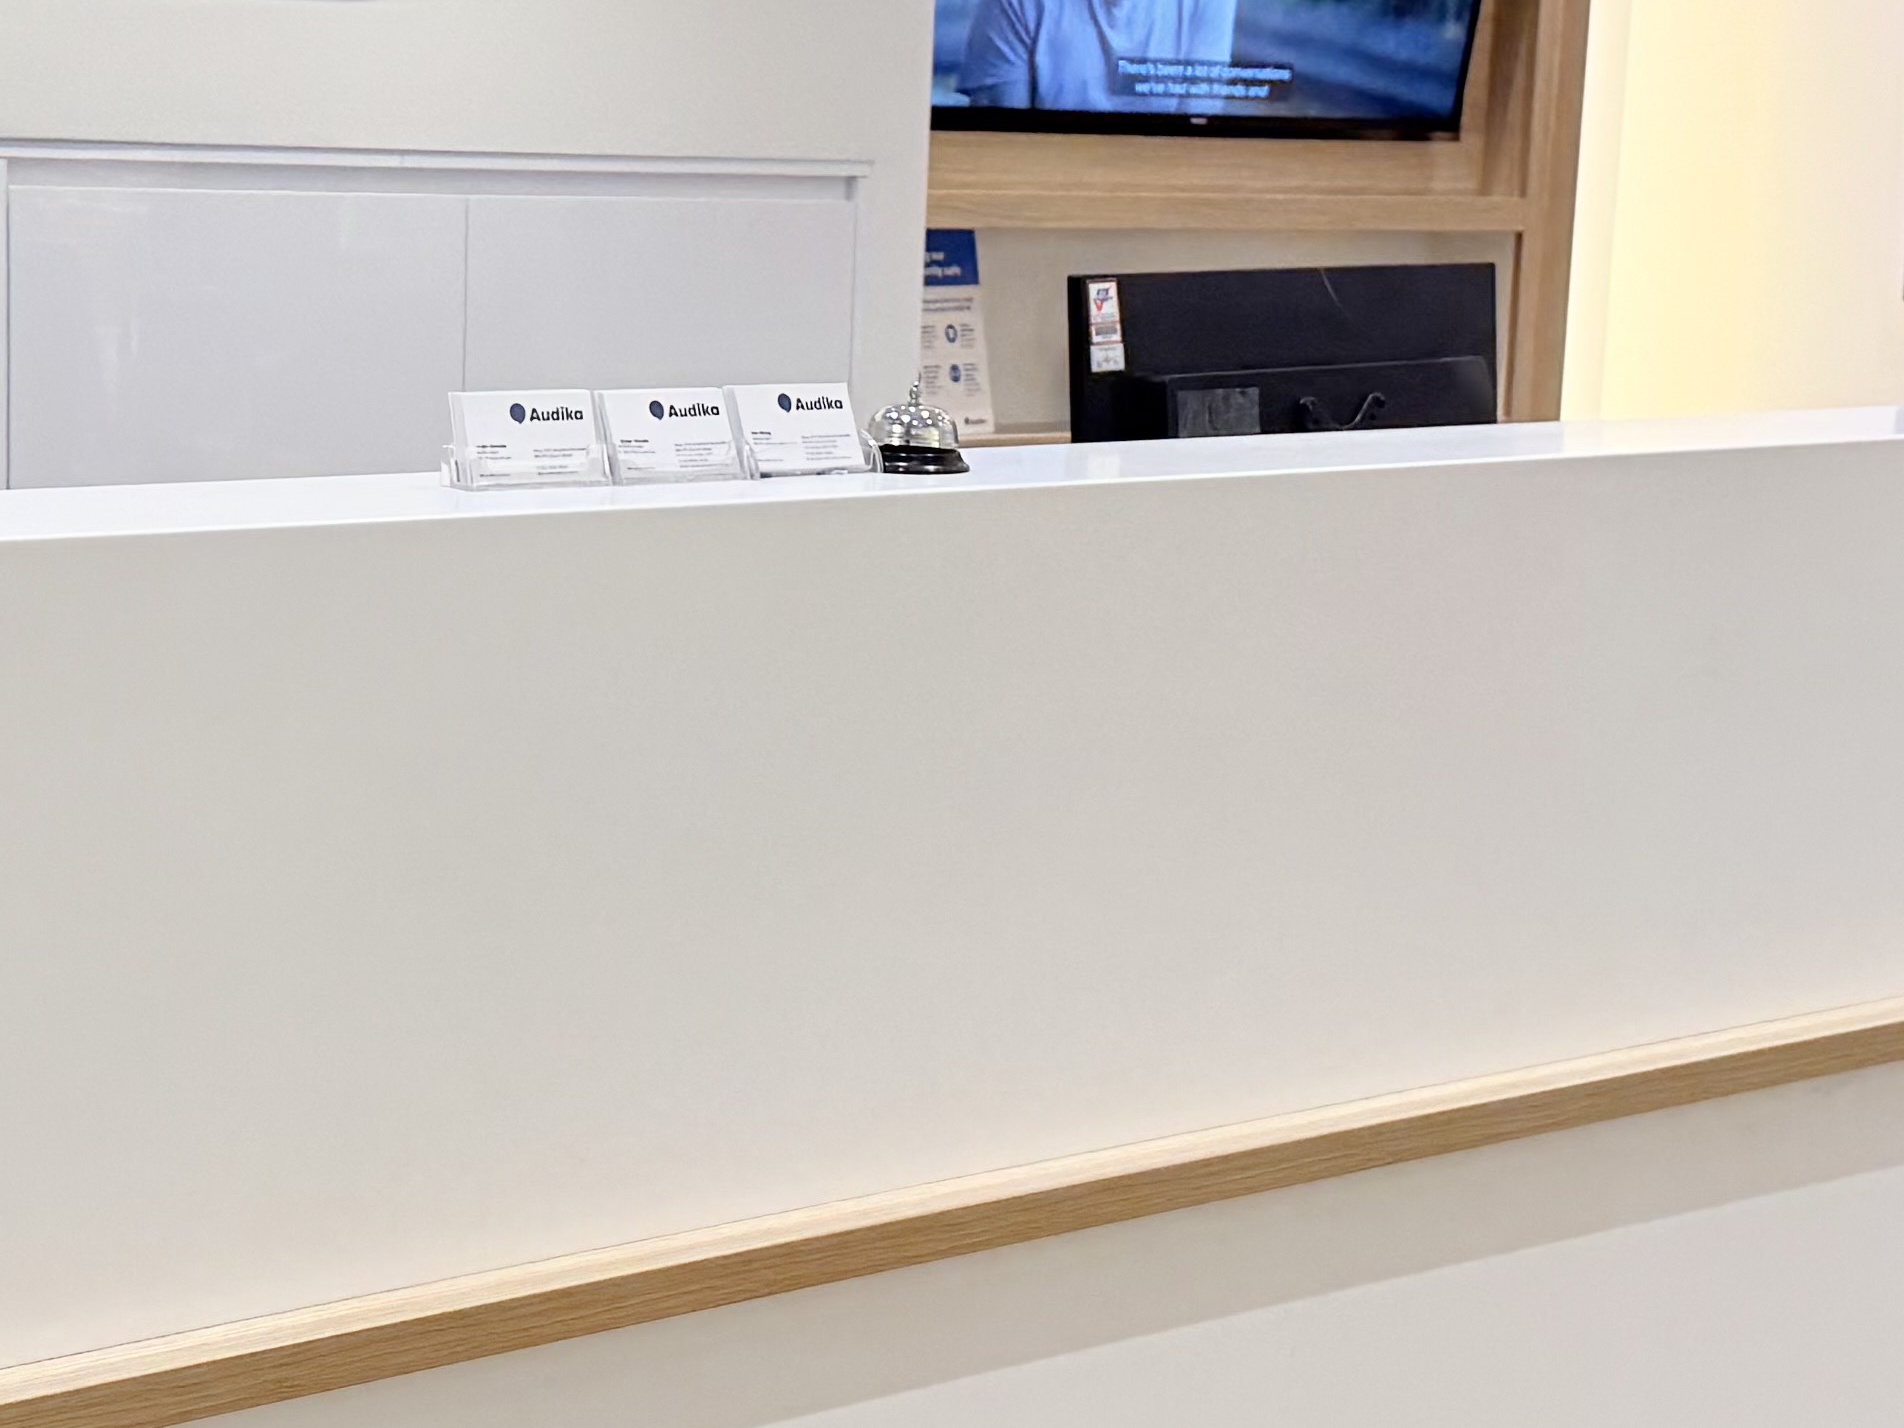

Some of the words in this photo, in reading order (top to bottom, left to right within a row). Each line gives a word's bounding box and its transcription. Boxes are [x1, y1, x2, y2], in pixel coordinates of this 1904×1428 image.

[668, 403, 721, 419] Audika
[796, 396, 843, 412] Audika
[529, 406, 584, 422] Audika
